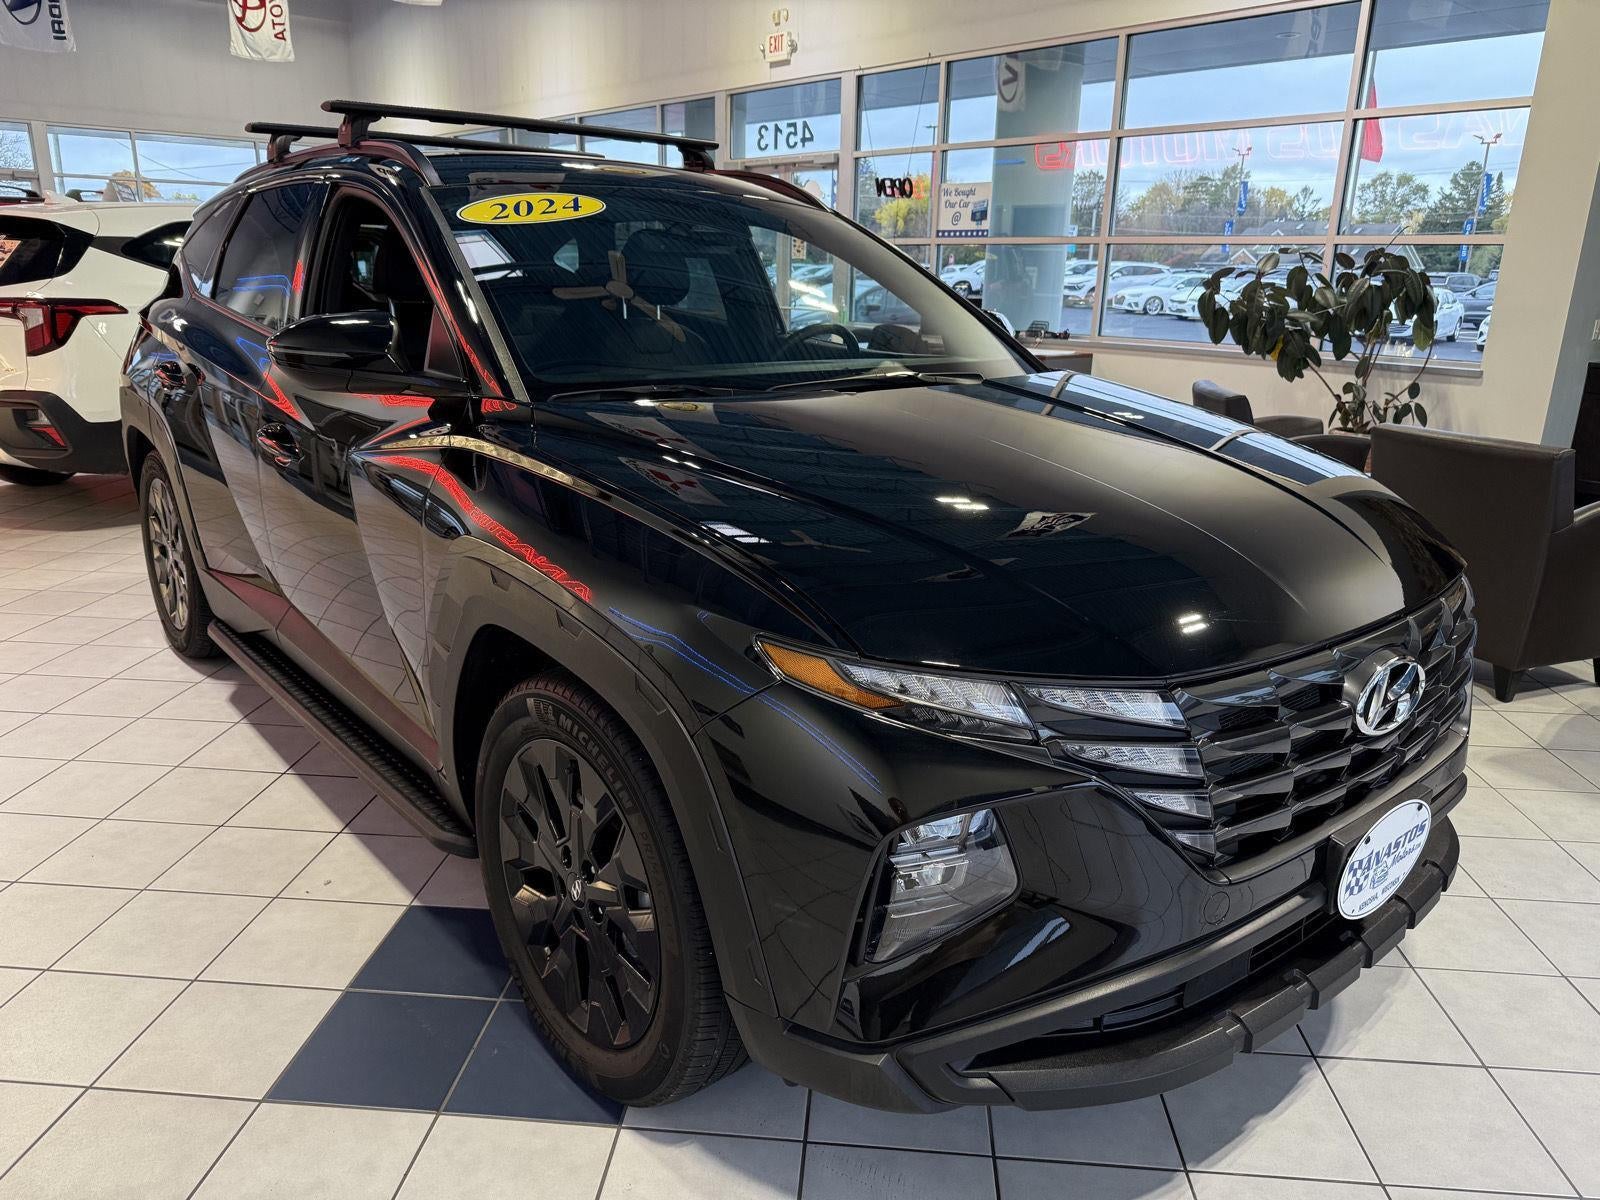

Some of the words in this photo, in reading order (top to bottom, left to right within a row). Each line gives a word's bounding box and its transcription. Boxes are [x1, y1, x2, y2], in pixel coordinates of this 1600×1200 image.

[768, 34, 784, 54] EXIT
[943, 187, 953, 197] We
[954, 187, 976, 198] Bought
[490, 197, 582, 220] 2024
[945, 199, 958, 208] Our
[959, 199, 970, 208] Car
[559, 714, 635, 816] MICHELIN
[1360, 818, 1428, 877] ANASTOS
